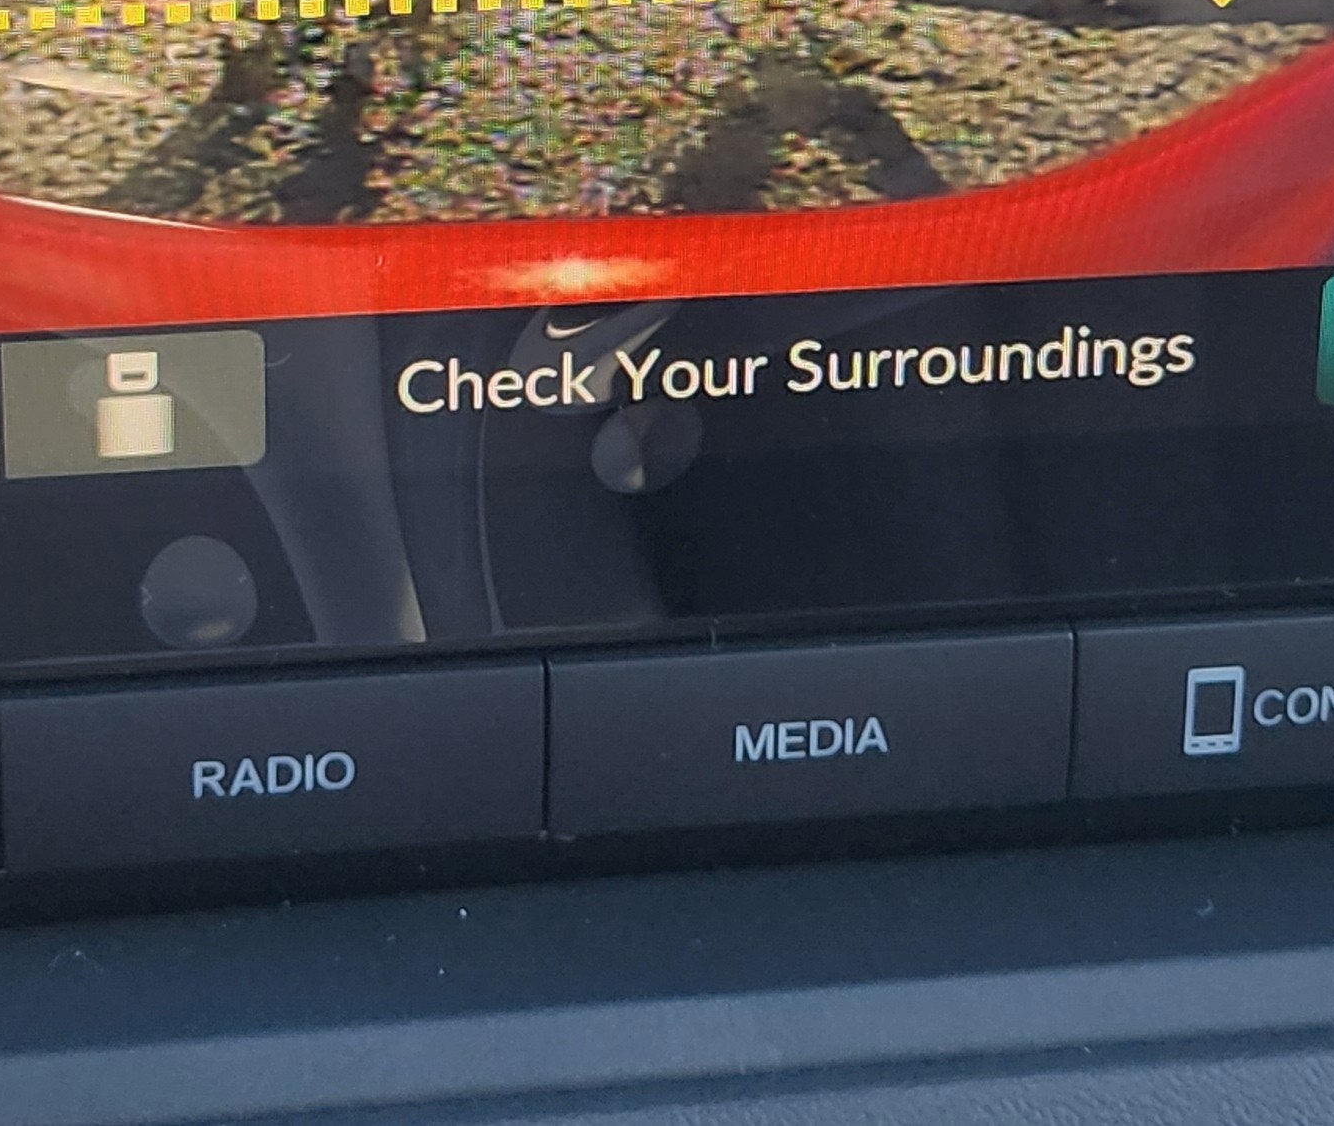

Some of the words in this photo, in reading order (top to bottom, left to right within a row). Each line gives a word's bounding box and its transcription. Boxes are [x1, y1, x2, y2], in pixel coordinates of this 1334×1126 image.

[397, 351, 595, 414] Check
[612, 347, 767, 402] Your
[787, 325, 1195, 392] Surroundings
[734, 715, 888, 763] MEDIA
[192, 751, 355, 799] RADIO
